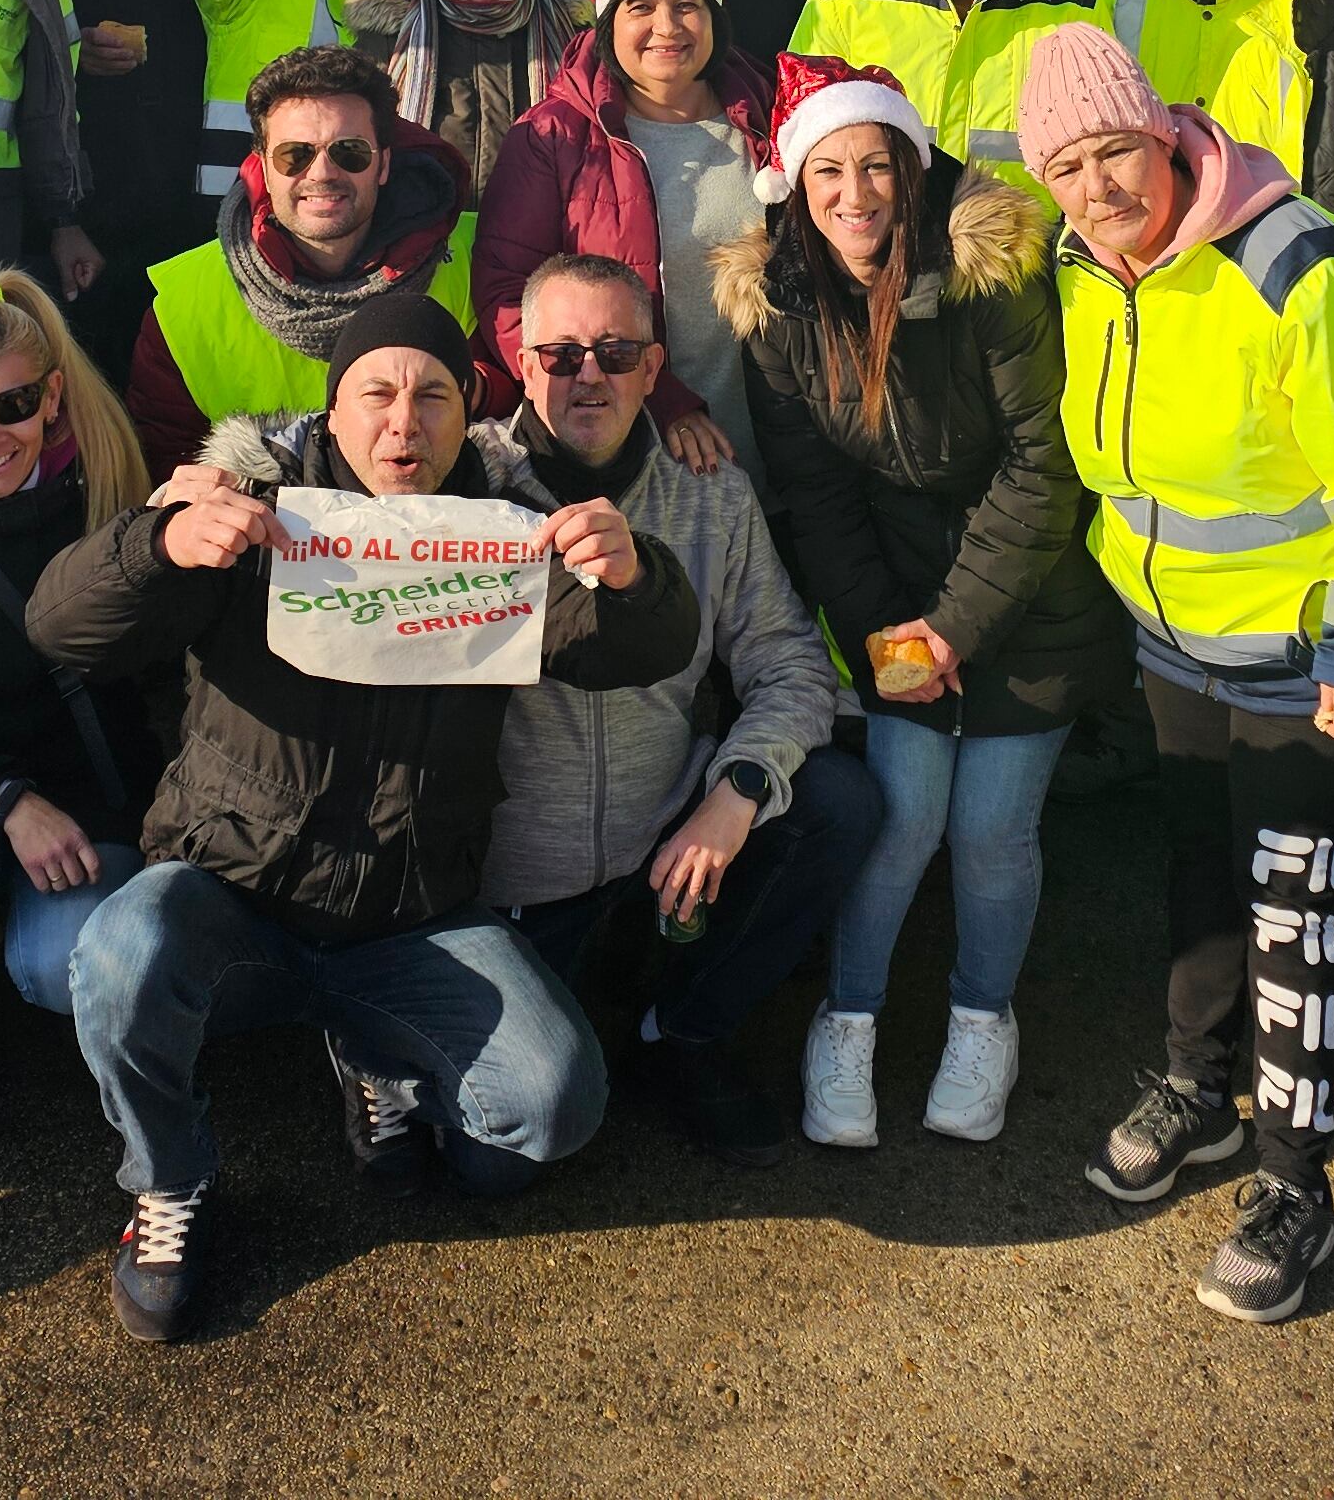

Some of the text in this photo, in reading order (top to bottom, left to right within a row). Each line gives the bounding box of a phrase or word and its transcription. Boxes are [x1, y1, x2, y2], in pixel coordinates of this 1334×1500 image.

[362, 538, 400, 561] AL
[278, 570, 521, 613] Schneider
[395, 589, 526, 616] Electric
[396, 602, 534, 636] GRIÑÓN
